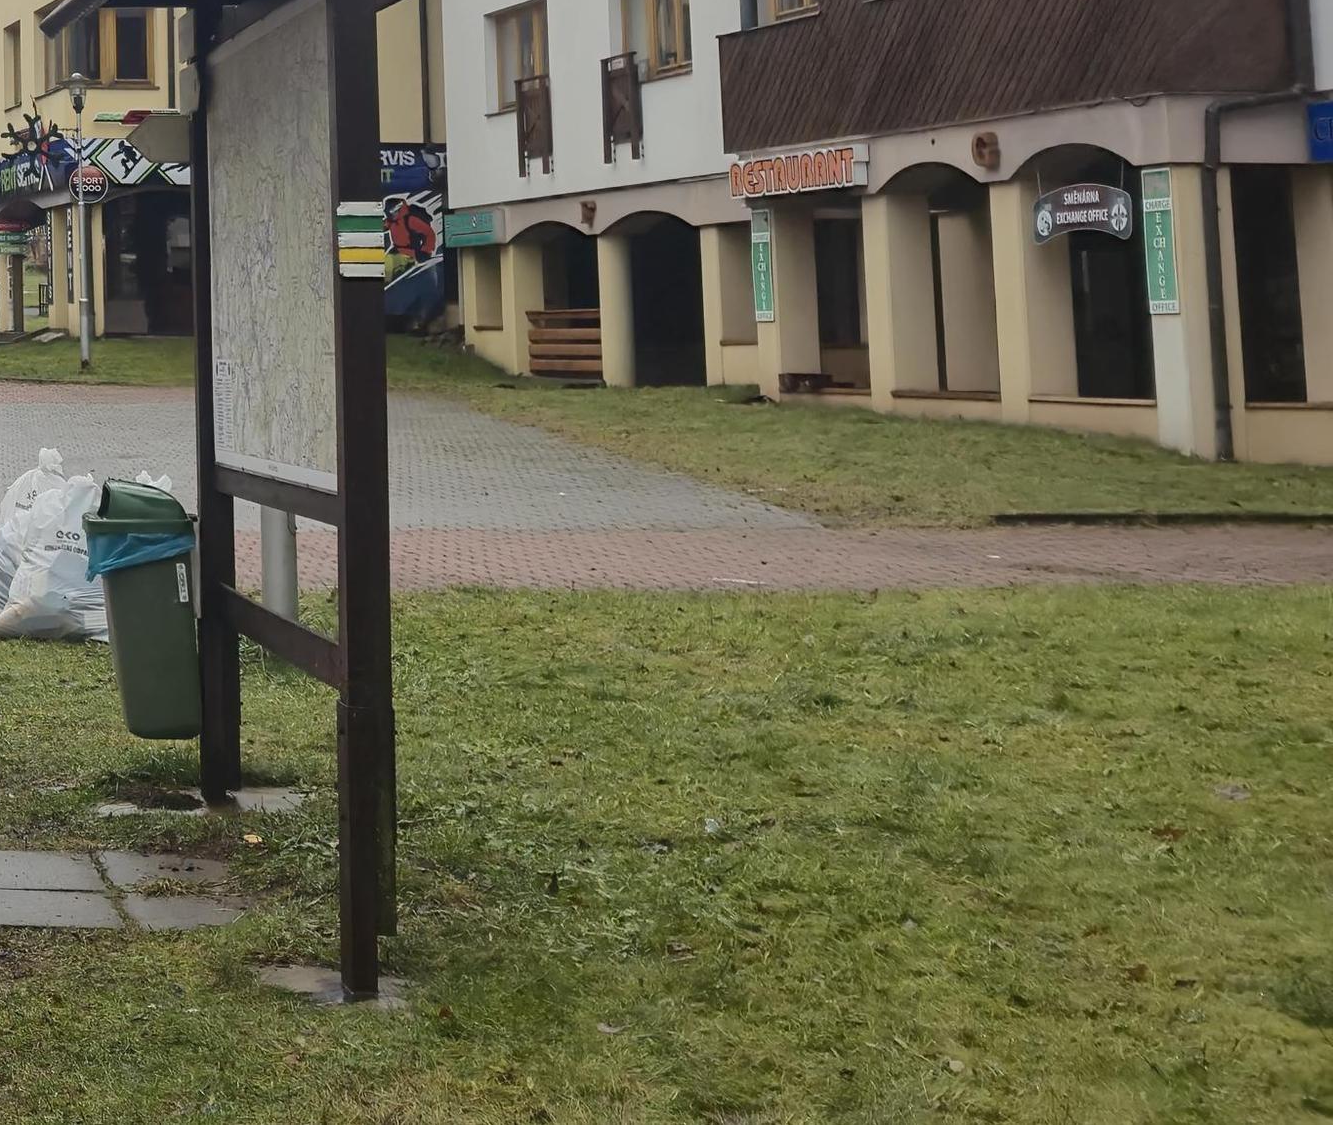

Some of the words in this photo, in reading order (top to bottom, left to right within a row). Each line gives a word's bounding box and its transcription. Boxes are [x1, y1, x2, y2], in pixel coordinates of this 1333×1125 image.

[381, 150, 415, 166] RVIS
[730, 147, 854, 197] RESTAURANT
[73, 177, 104, 185] SPORT
[76, 184, 102, 192] 2000
[1063, 190, 1100, 205] SMĚNÁRNA
[1056, 210, 1087, 224] EXCHANGE
[1088, 208, 1109, 222] OFFICE
[1153, 212, 1166, 299] EXCHANGE
[1151, 302, 1177, 312] OFFICE
